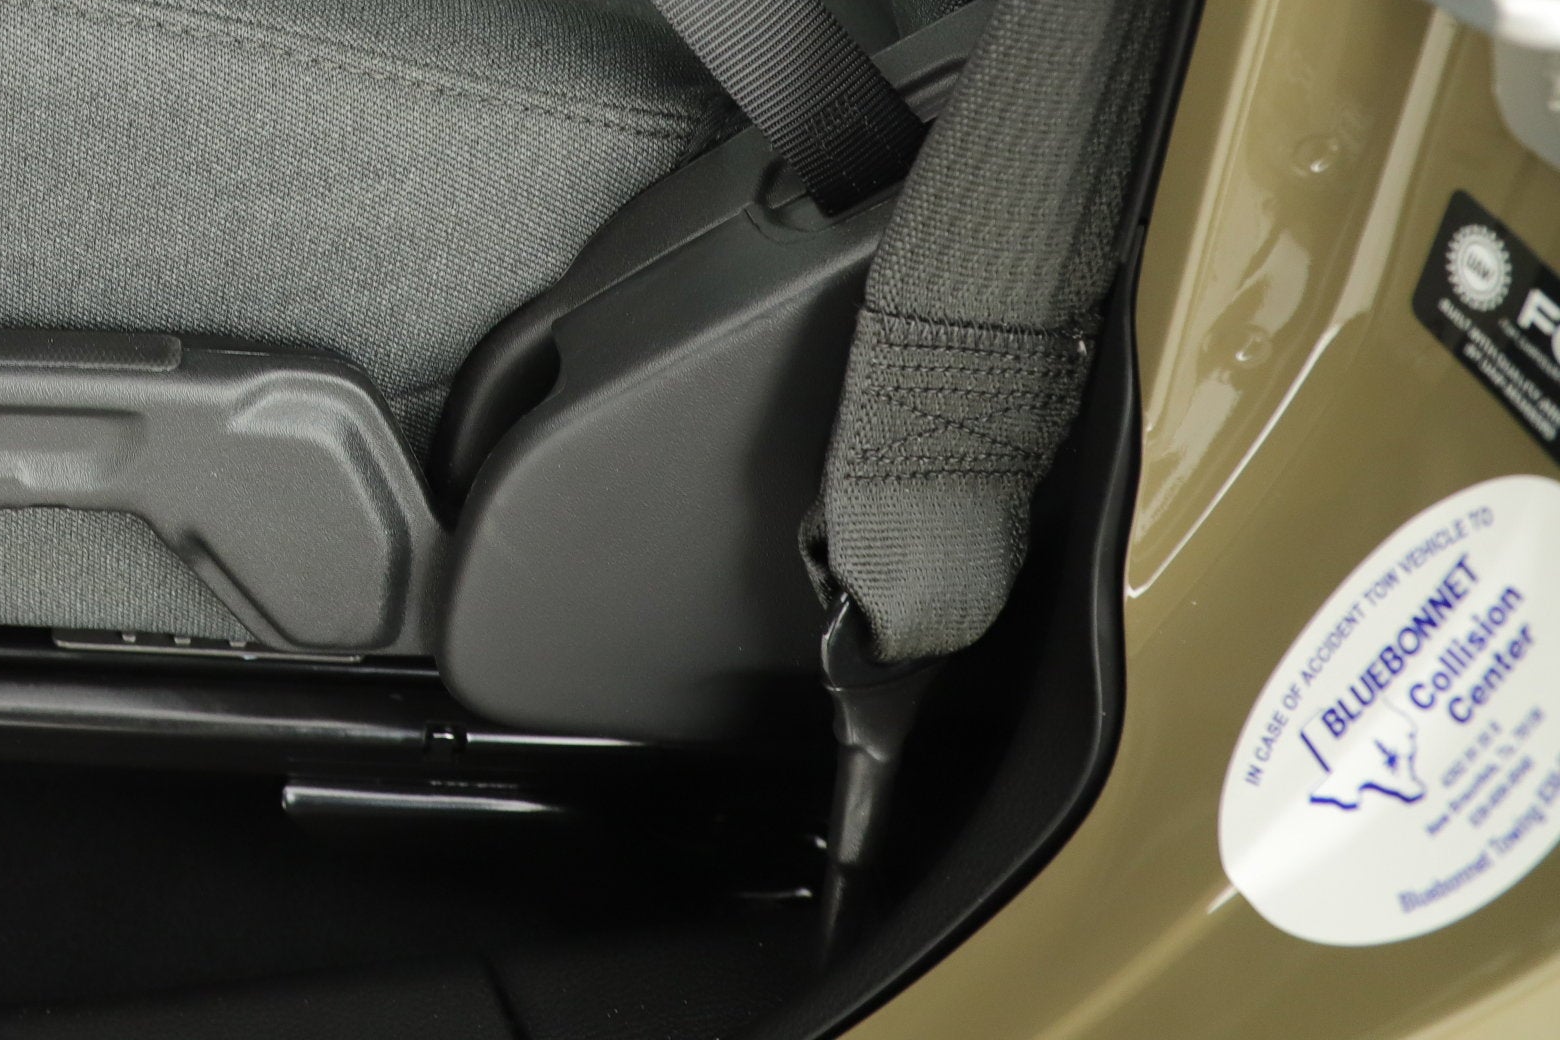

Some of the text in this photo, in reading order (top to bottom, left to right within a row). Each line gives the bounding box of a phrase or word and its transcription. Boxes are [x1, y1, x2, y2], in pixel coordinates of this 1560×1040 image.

[1245, 506, 1494, 786] IN CASE OF ACCIDENT TOW VEHICLE TO
[1322, 553, 1479, 738] BLUEBONNET
[1409, 586, 1524, 710] Collision
[1448, 623, 1534, 725] Center
